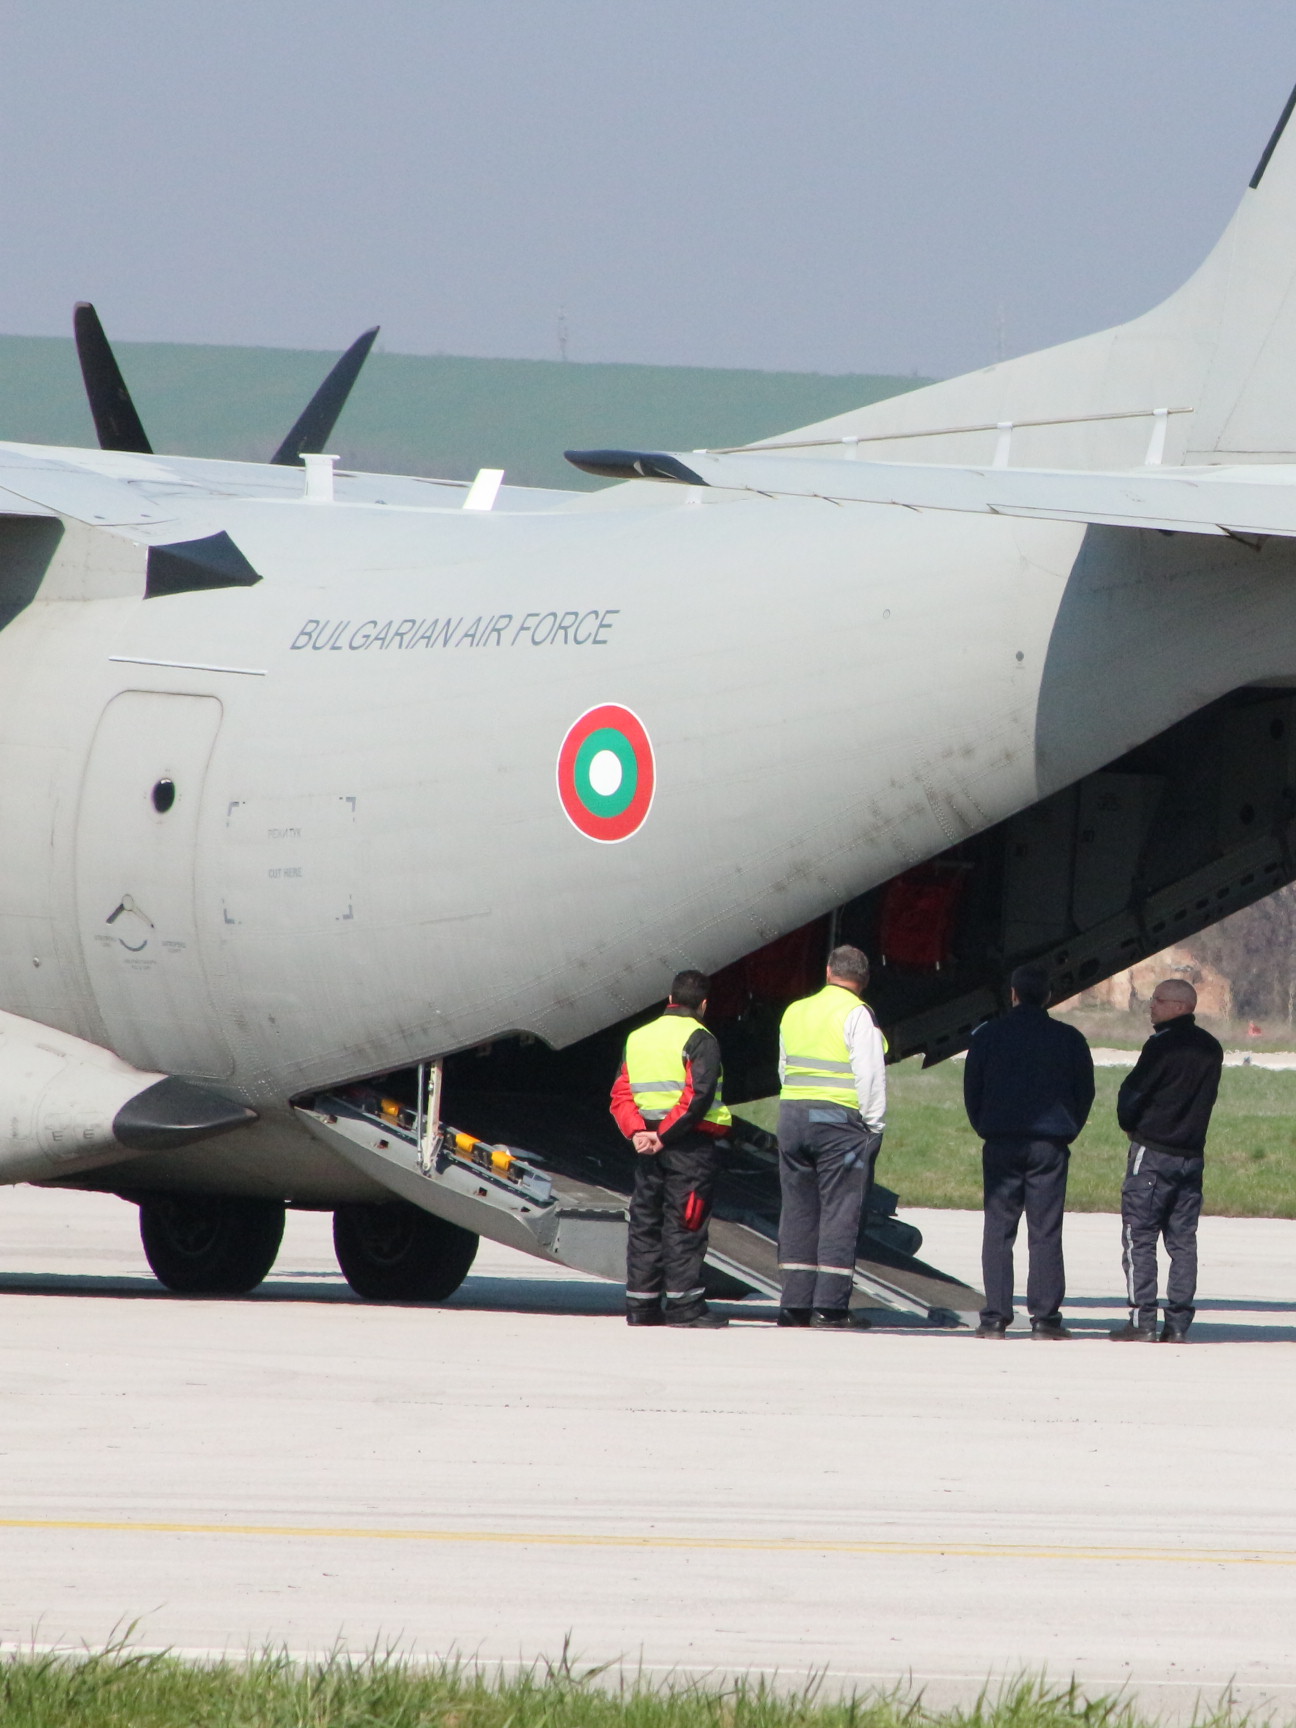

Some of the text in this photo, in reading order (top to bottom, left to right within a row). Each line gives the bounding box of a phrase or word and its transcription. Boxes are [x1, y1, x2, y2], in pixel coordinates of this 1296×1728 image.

[290, 610, 620, 651] BULGARIAN AIR FORCE
